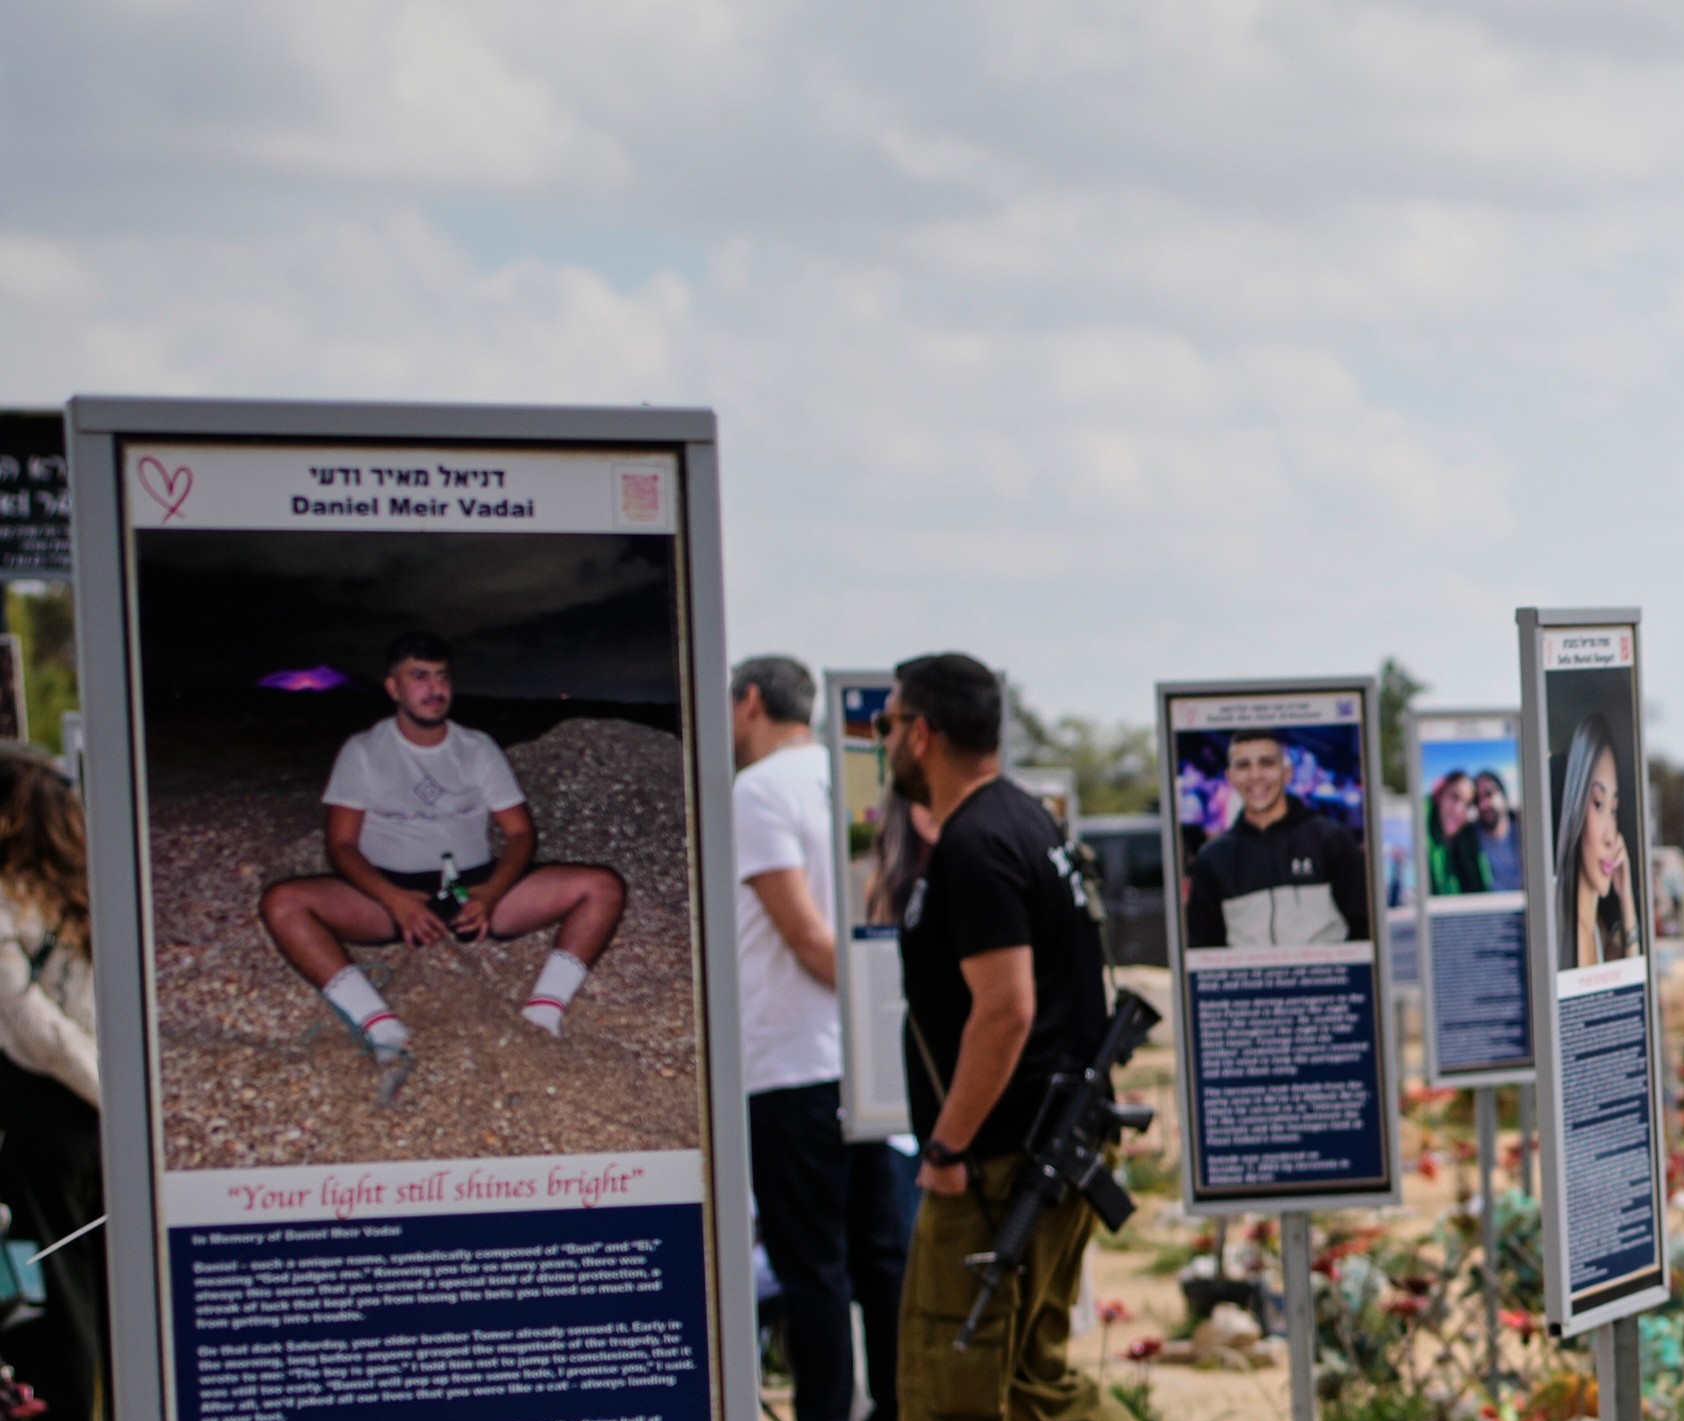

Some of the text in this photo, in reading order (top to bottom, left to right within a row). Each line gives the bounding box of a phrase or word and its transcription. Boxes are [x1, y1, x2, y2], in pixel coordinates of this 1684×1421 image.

[309, 464, 505, 488] דניאל מאיר ודעי
[291, 497, 535, 518] Daniel Meir Vadai
[321, 1173, 387, 1221] light
[395, 1169, 451, 1204] still
[453, 1168, 537, 1202] shines
